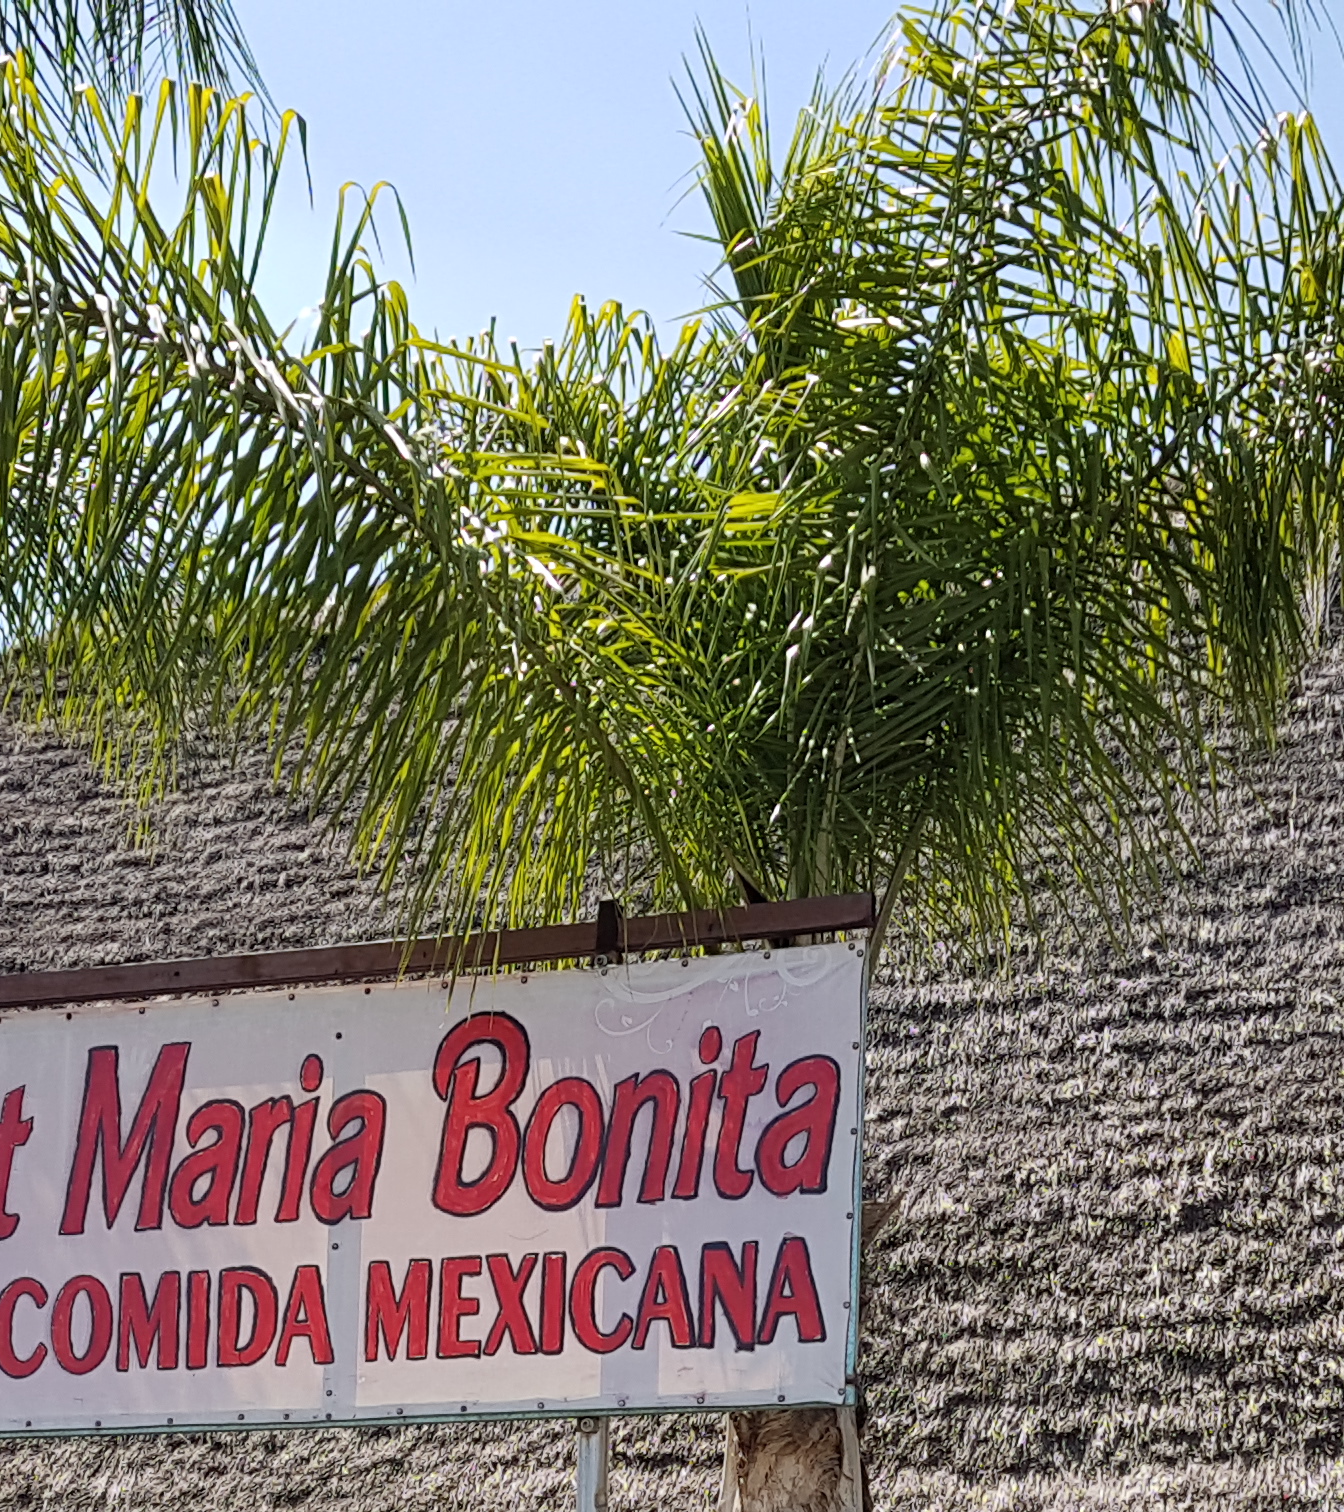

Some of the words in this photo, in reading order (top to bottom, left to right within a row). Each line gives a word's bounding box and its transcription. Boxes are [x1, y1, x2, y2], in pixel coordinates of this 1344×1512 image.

[59, 1042, 386, 1235] Maria
[433, 1011, 841, 1217] Bonita
[365, 1236, 826, 1362] MEXICANA
